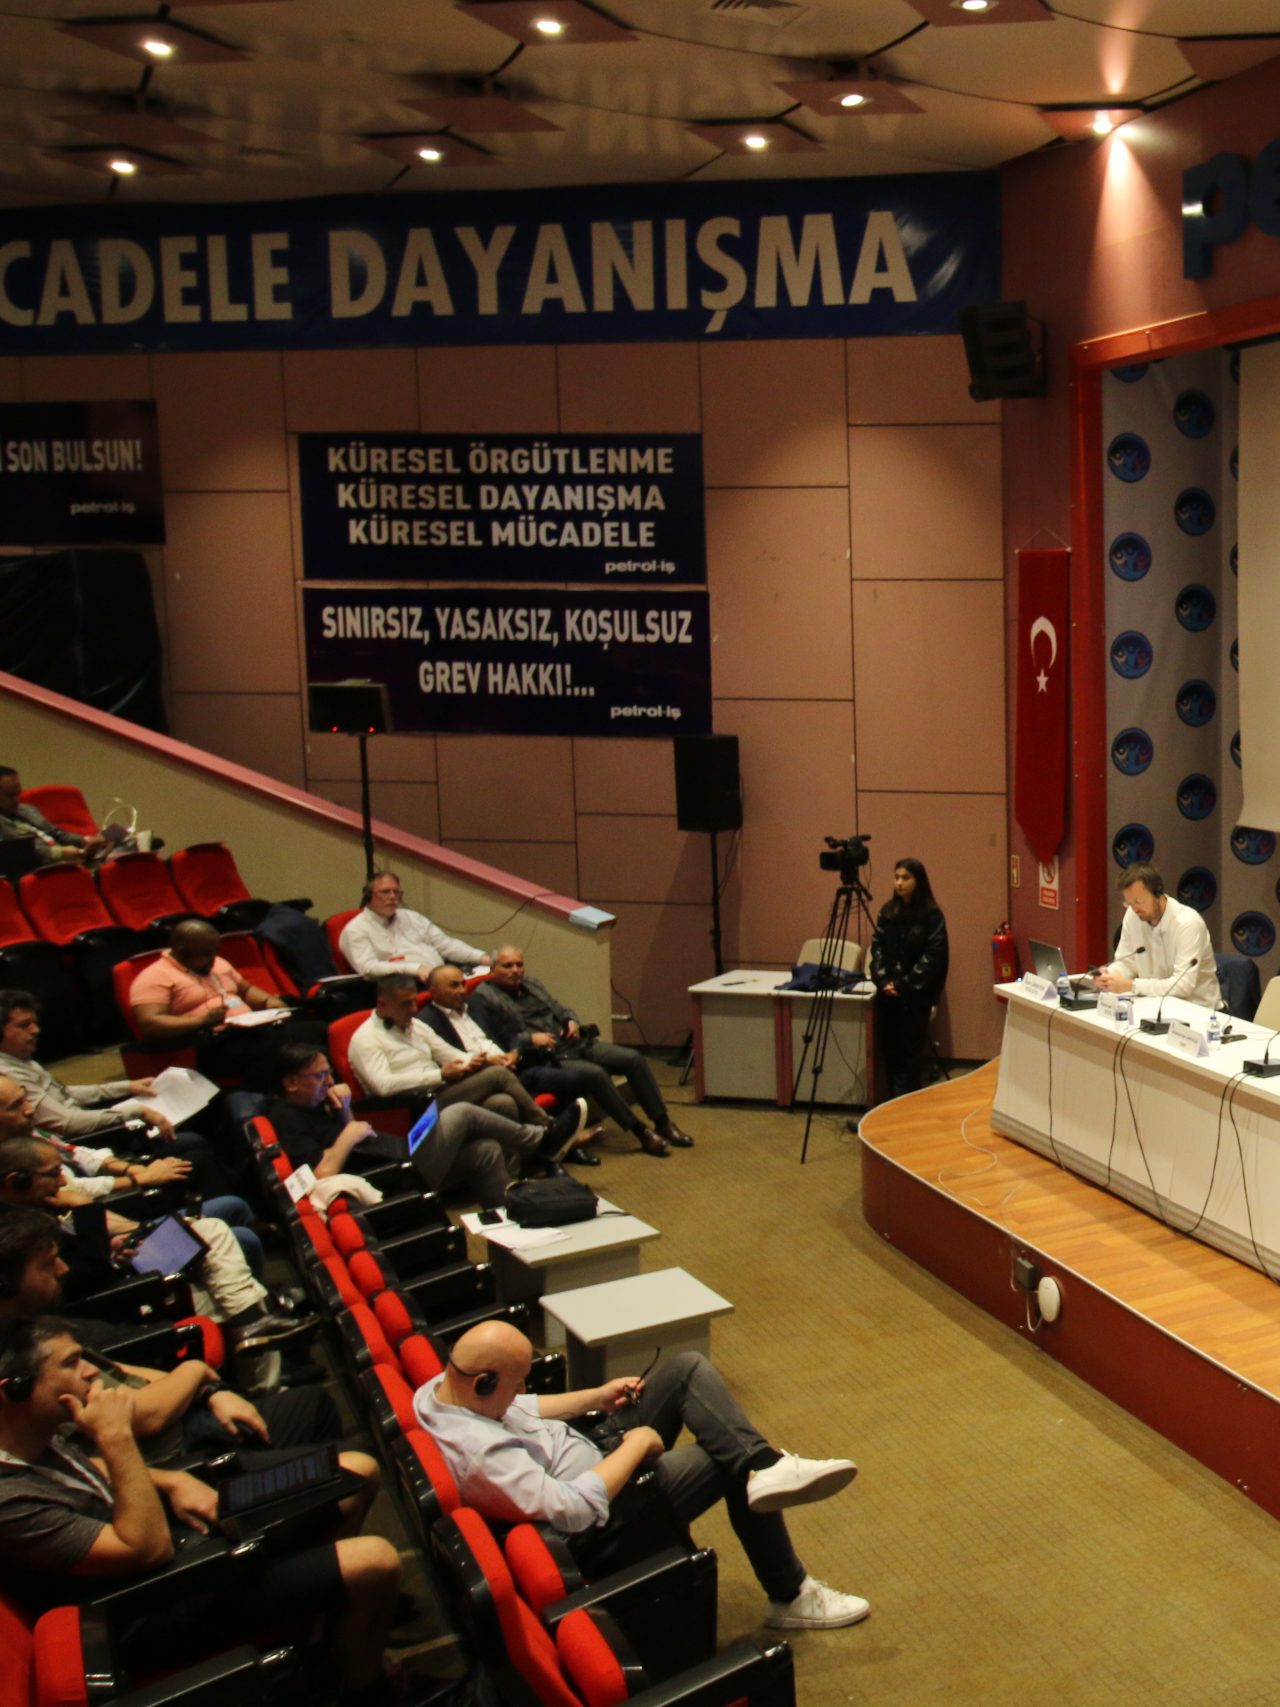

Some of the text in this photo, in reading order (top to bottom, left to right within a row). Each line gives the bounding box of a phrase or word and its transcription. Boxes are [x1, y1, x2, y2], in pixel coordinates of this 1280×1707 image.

[328, 210, 918, 334] DAYANIŞMA
[7, 440, 143, 473] SON BULSUN!
[327, 442, 674, 474] KÜRESEL ÖRGÜTLENME
[337, 478, 665, 518] KÜRESEL DAYANIŞMA
[348, 514, 656, 547] KÜRESEL MÜCADELE
[321, 606, 693, 651] SINIRSIZ, YASAKSIZ, KOŞULSUZ
[419, 660, 482, 694] GREV
